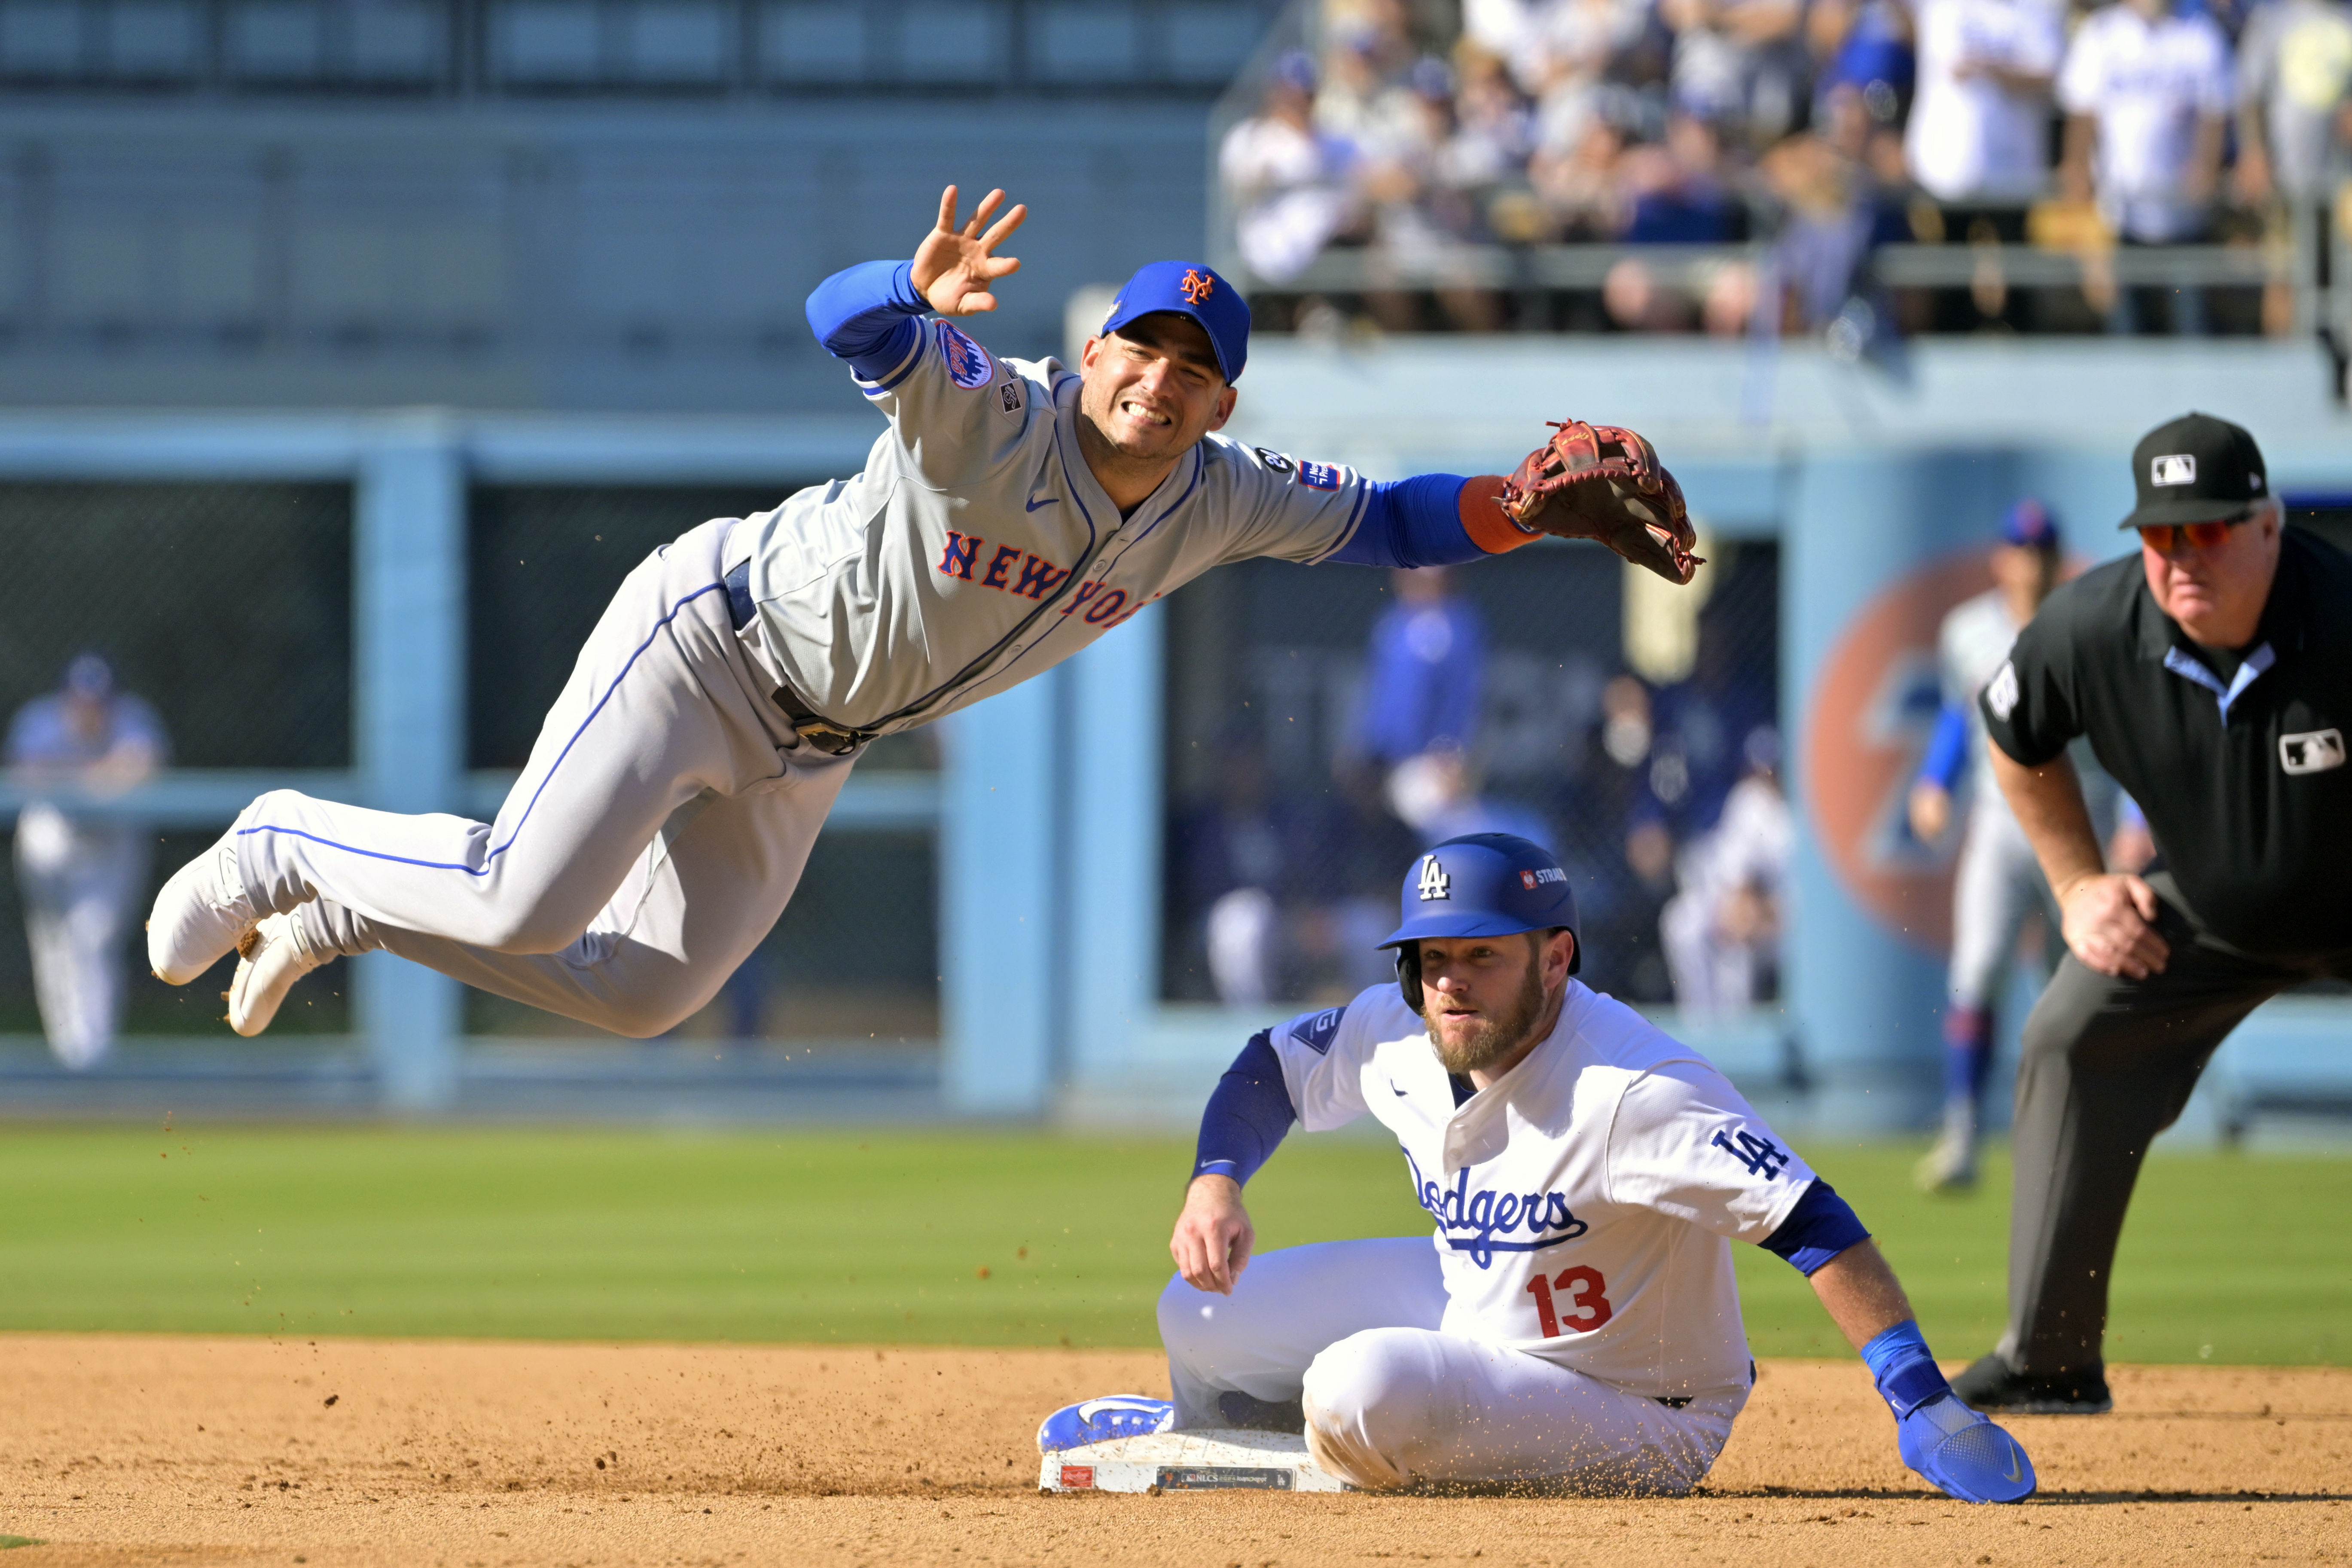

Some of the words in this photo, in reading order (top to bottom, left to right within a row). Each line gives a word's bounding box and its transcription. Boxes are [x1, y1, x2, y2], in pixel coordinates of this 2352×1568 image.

[946, 329, 968, 377] Mets
[938, 530, 1071, 600] NEW
[1060, 580, 1161, 629] YO
[1418, 854, 1449, 901] LA
[1711, 1129, 1790, 1182] LA
[1526, 1265, 1612, 1339] 13
[1196, 1474, 1219, 1483] NLCS
